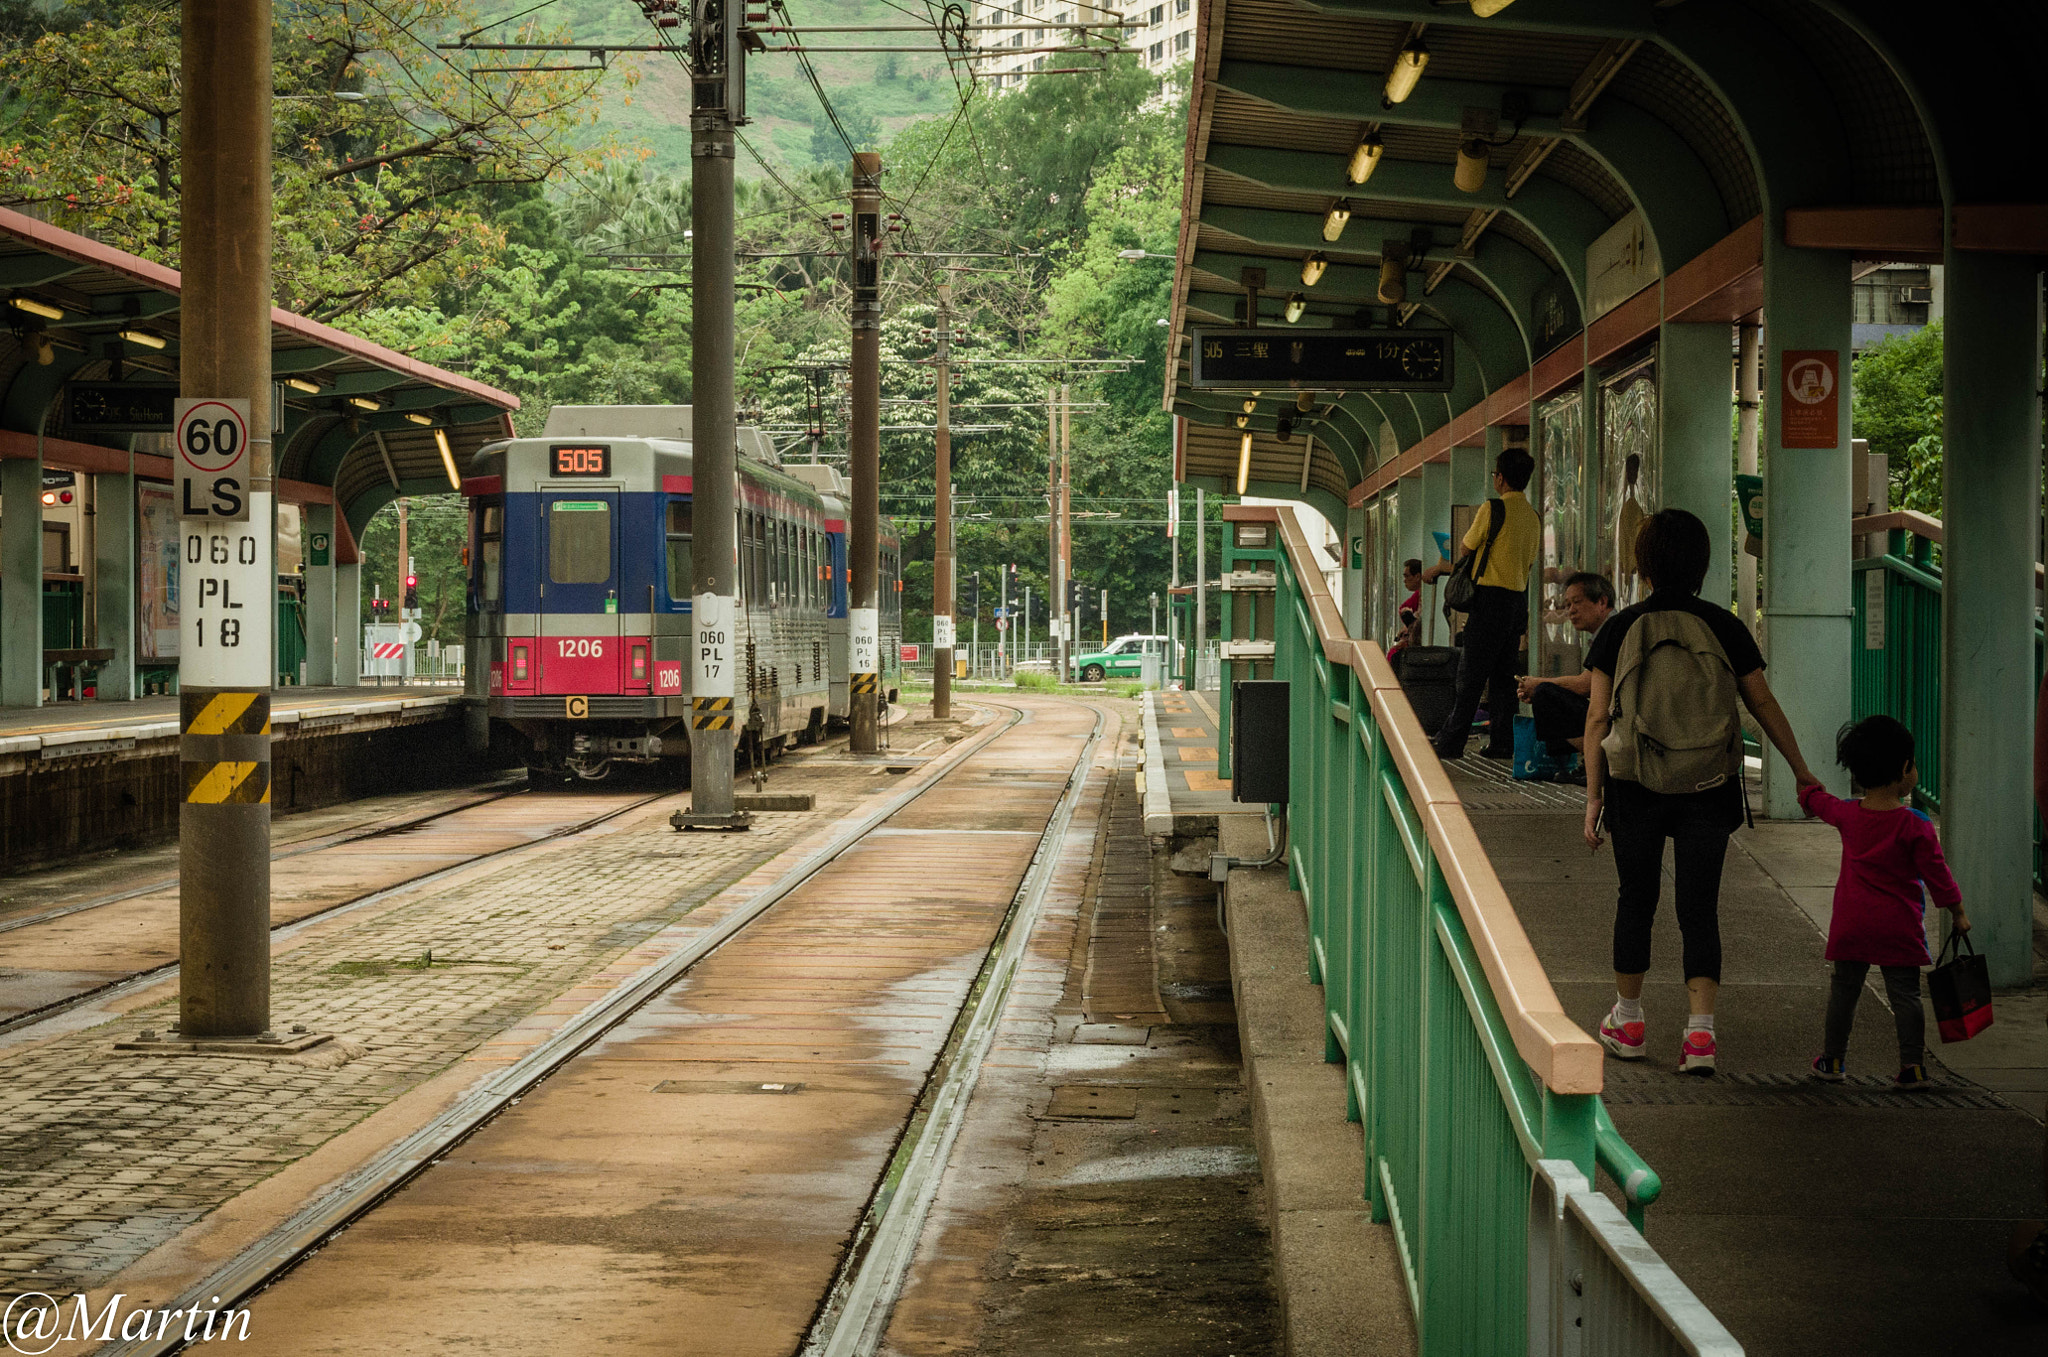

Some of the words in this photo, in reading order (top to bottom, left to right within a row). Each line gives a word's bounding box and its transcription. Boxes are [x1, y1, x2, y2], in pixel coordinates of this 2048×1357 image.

[1203, 341, 1222, 358] 505
[186, 419, 237, 455] 60
[558, 449, 602, 472] 505
[182, 477, 242, 516] LS
[187, 535, 256, 565] 060
[198, 578, 243, 608] PL
[196, 618, 240, 647] 18
[700, 631, 725, 645] 060
[855, 636, 873, 645] 060
[557, 639, 603, 658] 1206
[701, 648, 724, 661] PL
[856, 648, 871, 657] PL
[659, 669, 679, 688] 1206
[704, 665, 720, 678] 17
[568, 697, 586, 717] C
